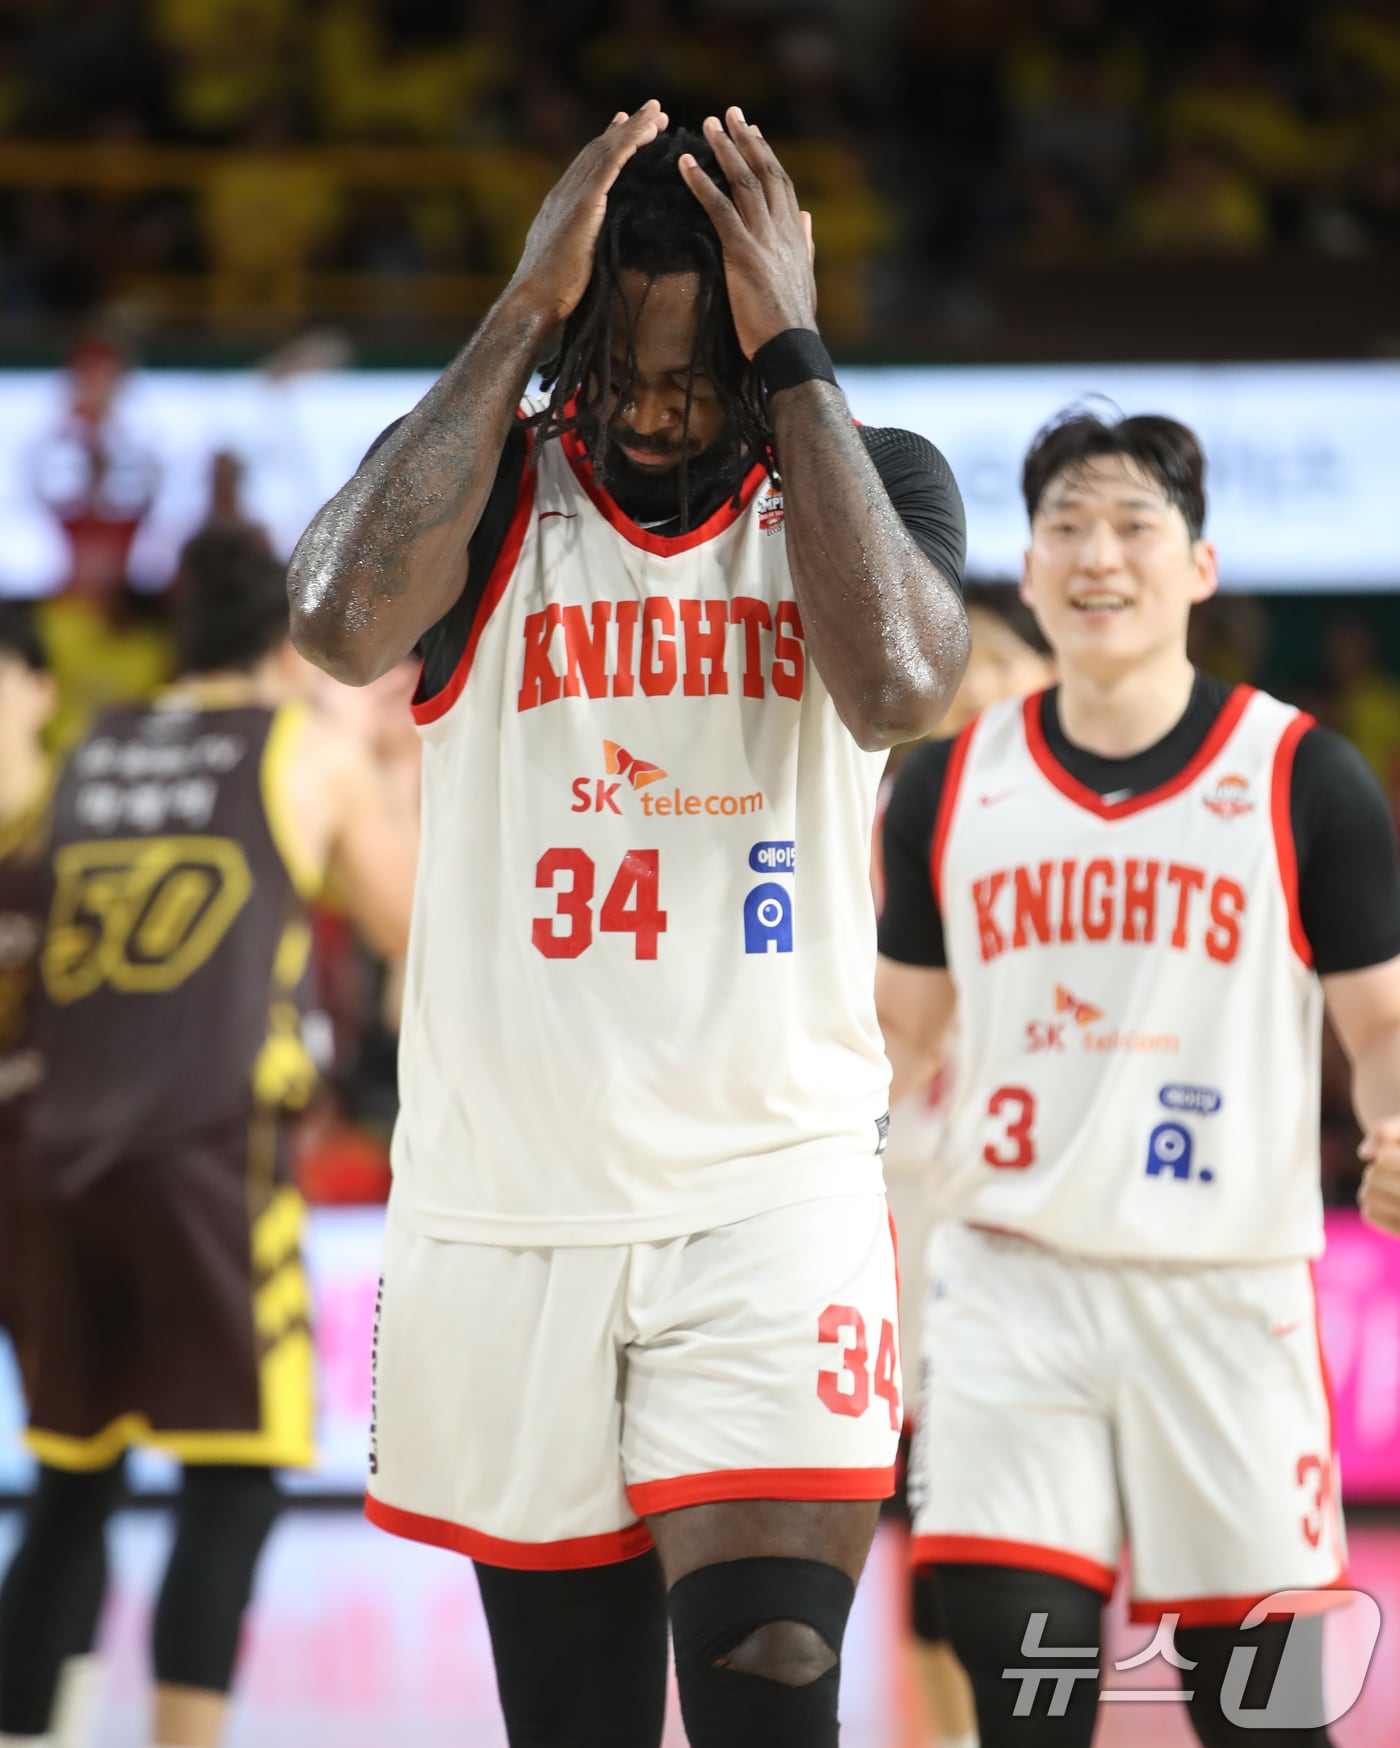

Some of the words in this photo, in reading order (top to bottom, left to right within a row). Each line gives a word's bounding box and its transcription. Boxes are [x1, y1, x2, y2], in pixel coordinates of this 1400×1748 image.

[517, 596, 805, 713] KNIGHTS
[570, 777, 623, 815] SK
[640, 787, 764, 816] telecom
[531, 847, 668, 960] 34
[972, 857, 1246, 964] KNIGHTS
[984, 1086, 1034, 1170] 3
[816, 1303, 901, 1433] 34
